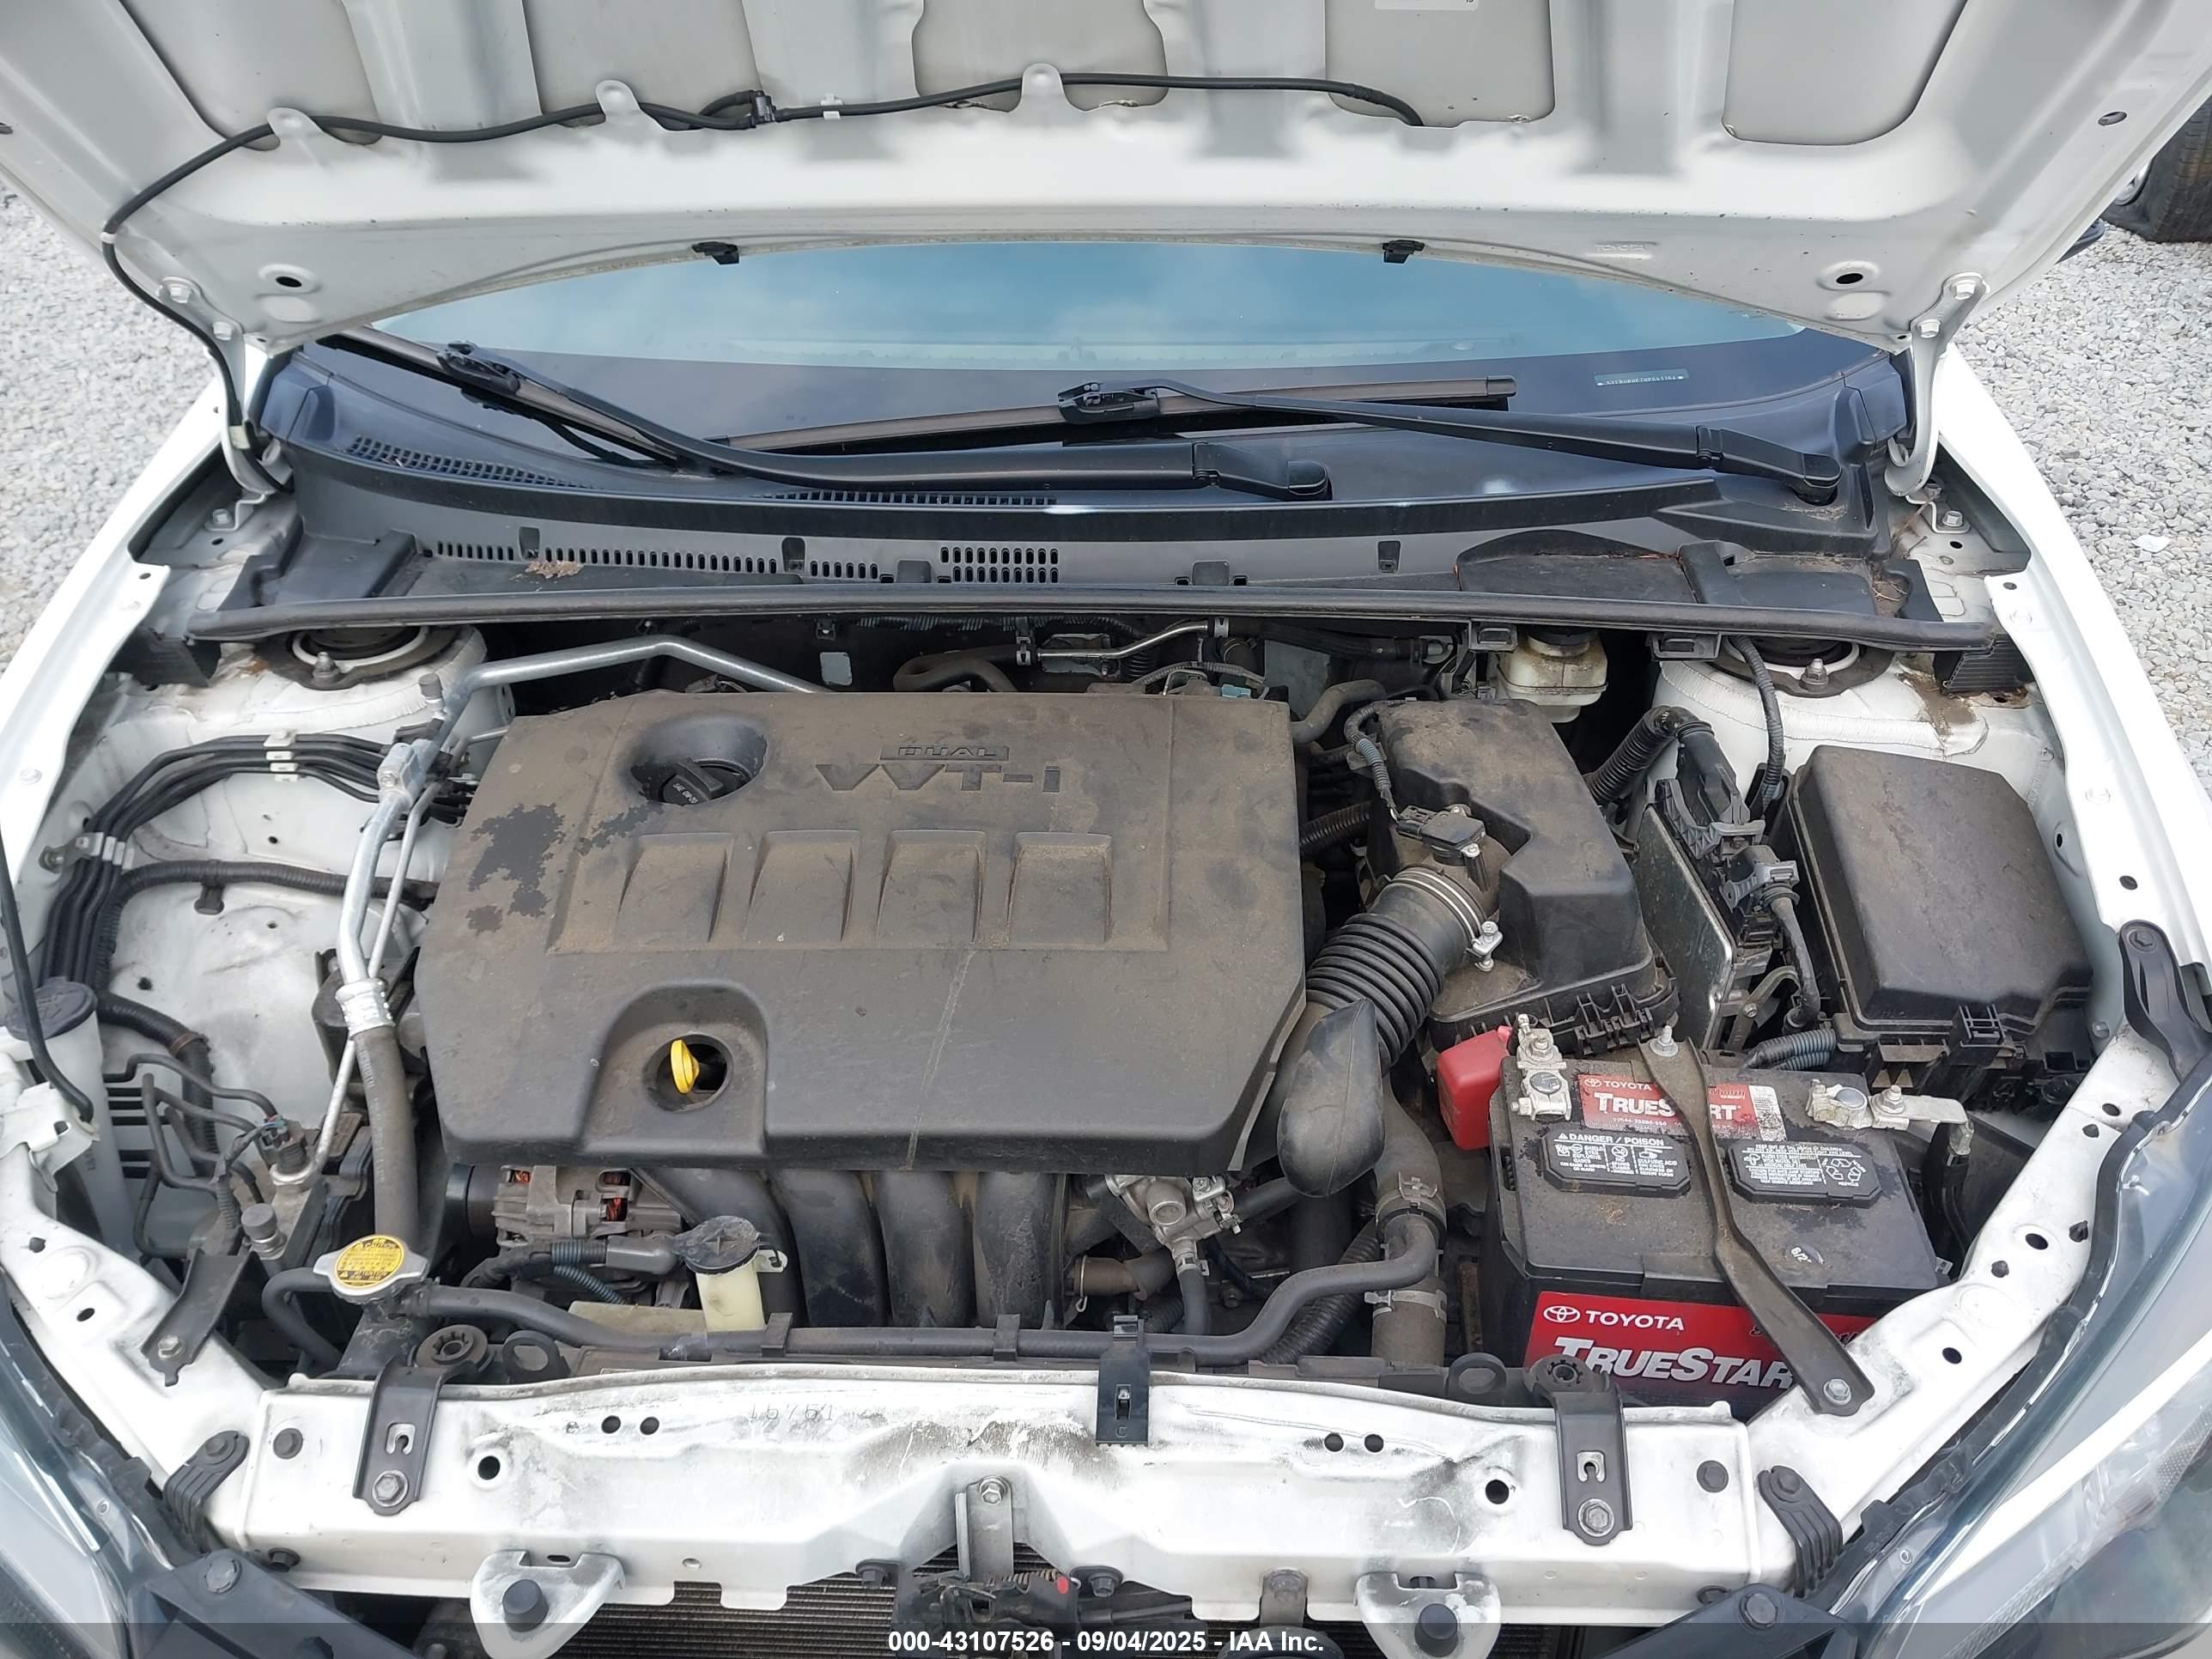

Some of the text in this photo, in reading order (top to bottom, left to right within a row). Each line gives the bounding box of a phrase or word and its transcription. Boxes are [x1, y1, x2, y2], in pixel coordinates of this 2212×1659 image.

[897, 746, 997, 757] DUAL
[1604, 1080, 1652, 1091] TOYOTA
[1569, 1133, 1613, 1143] DANGER
[1624, 1137, 1664, 1146] POISON
[1585, 1310, 1685, 1331] TOYOTA
